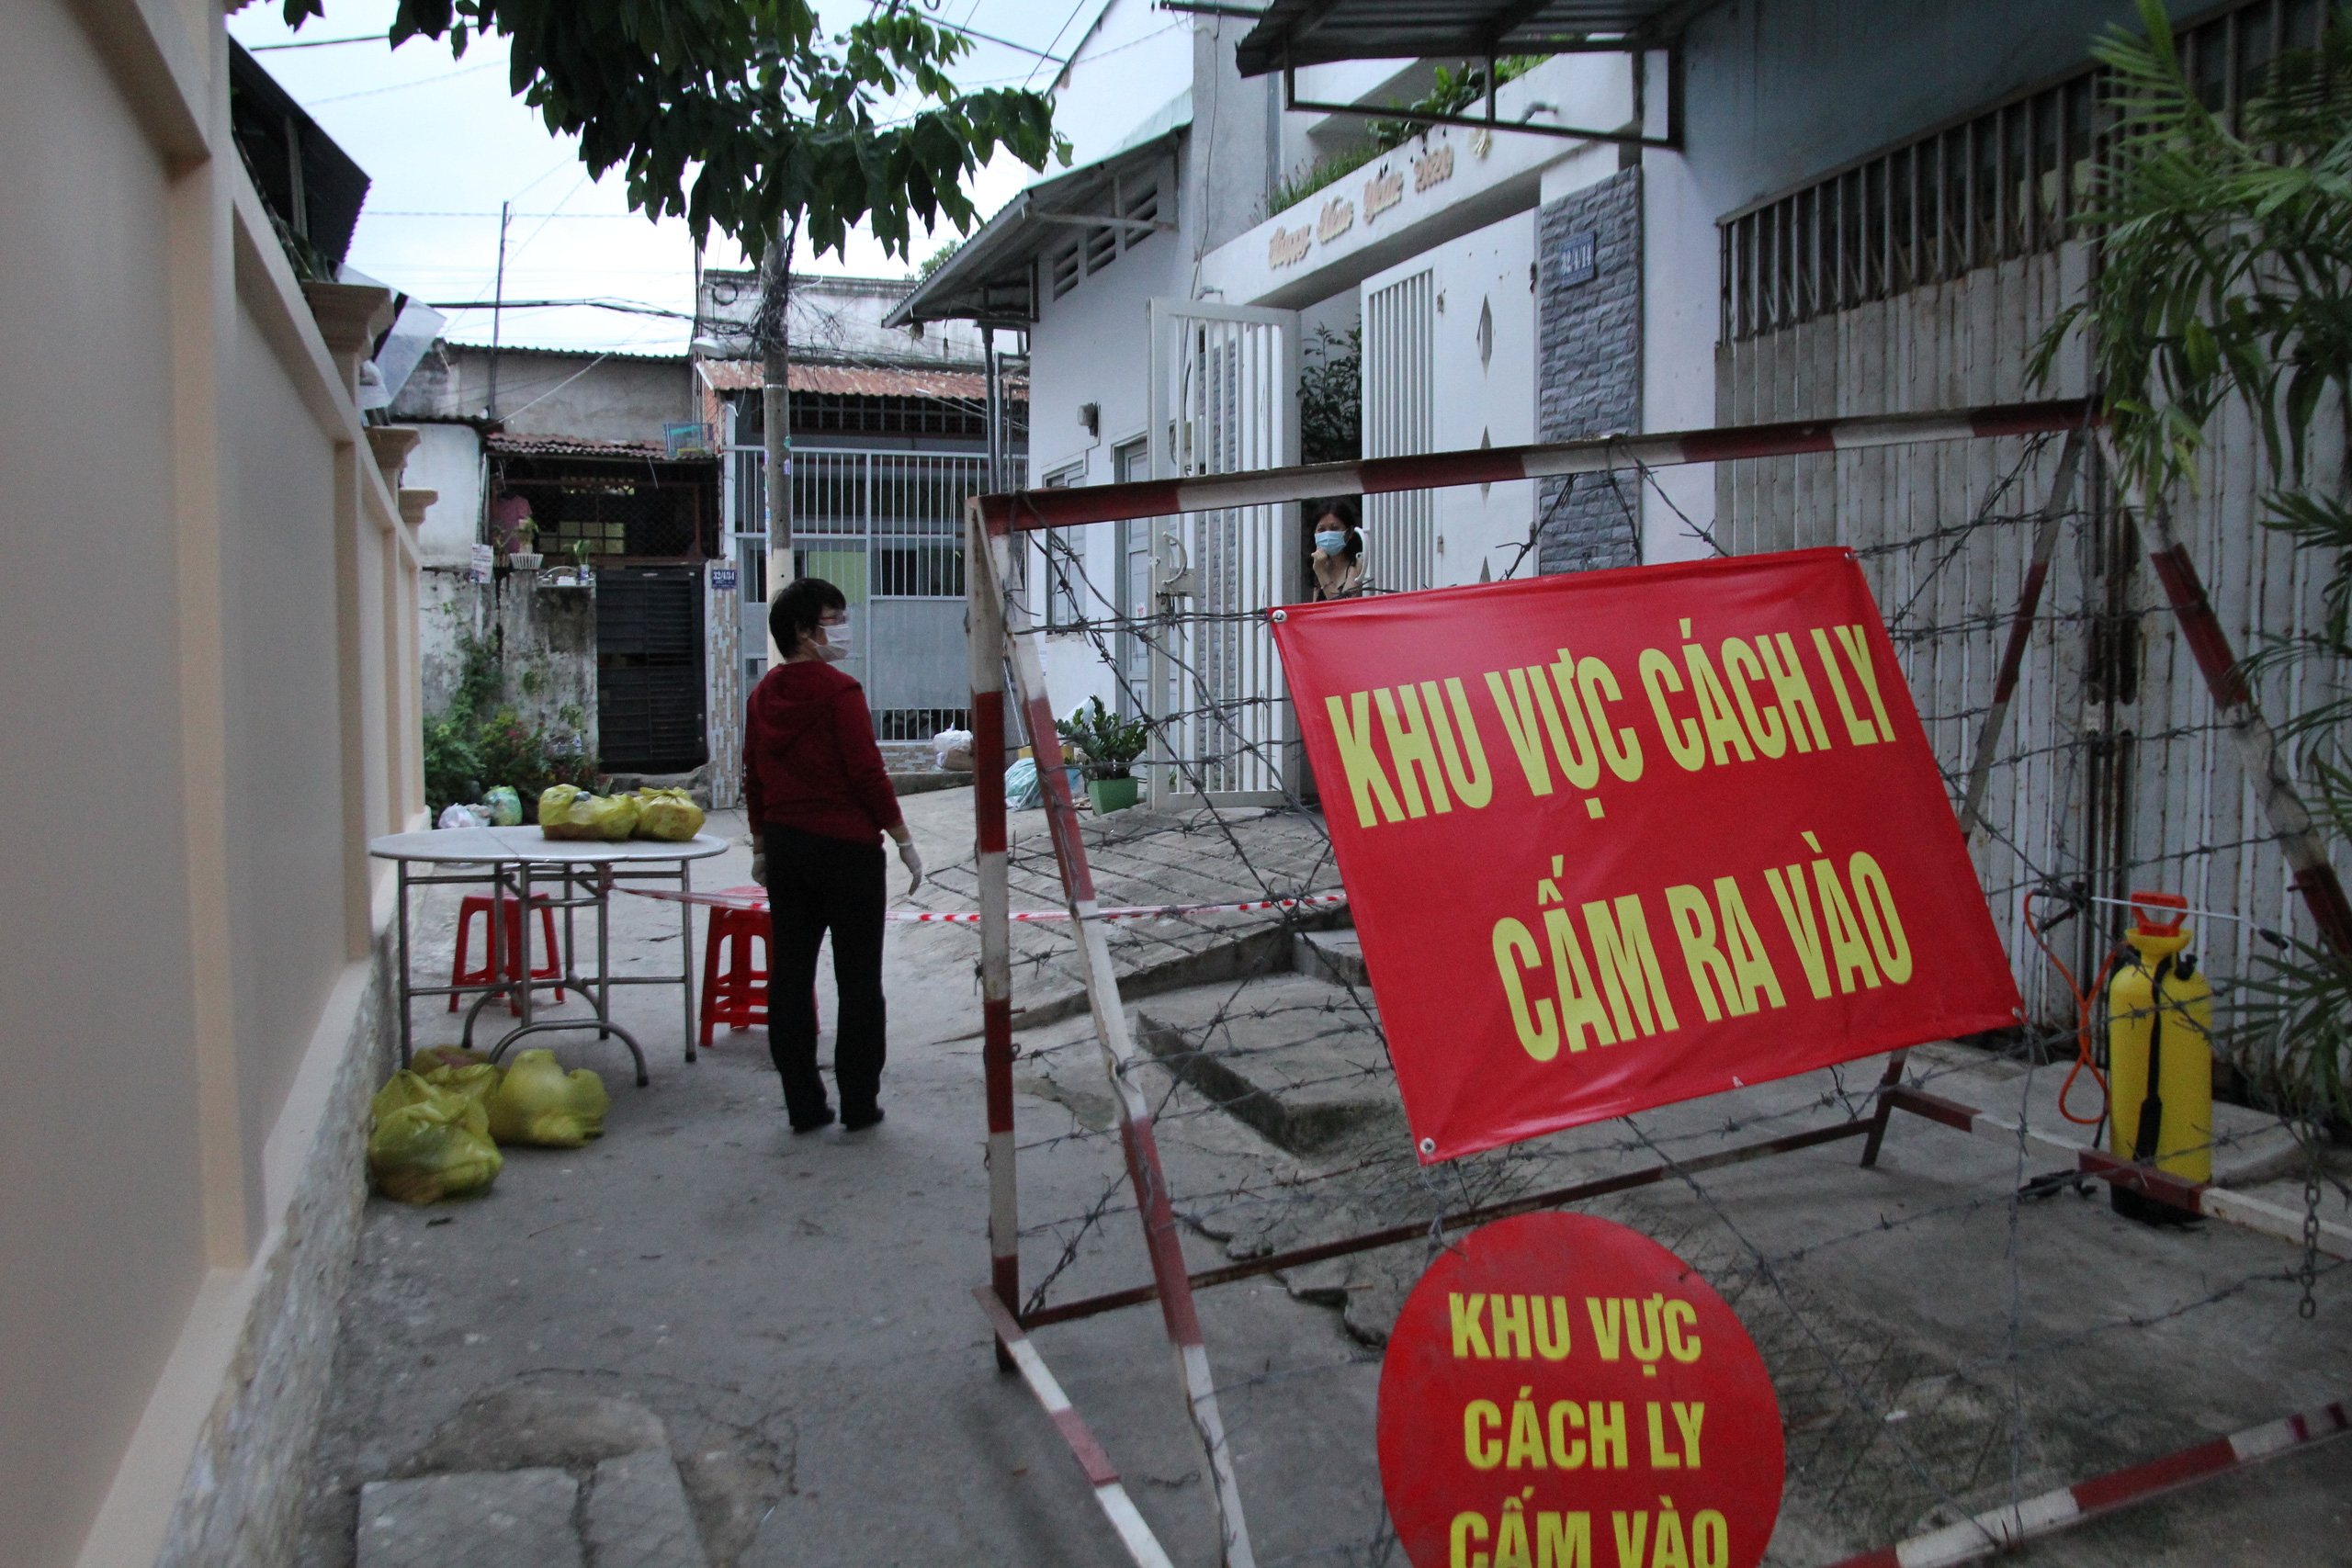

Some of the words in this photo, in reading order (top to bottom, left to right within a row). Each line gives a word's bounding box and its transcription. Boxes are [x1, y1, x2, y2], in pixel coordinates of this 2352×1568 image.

[1326, 679, 1492, 828] KHU
[1485, 649, 1644, 818] VỰC
[1639, 618, 1831, 772] CÁCH
[1811, 625, 1895, 745] LY
[1493, 855, 1679, 1061] CẤM
[1665, 876, 1786, 1021] RA
[1764, 831, 1912, 998] VÀO
[1449, 1292, 1570, 1360] KHU
[1586, 1293, 1701, 1376] VỰC
[1464, 1386, 1628, 1469] CÁCH
[1646, 1402, 1704, 1468] LY
[1451, 1486, 1590, 1568] CẤM
[1612, 1496, 1728, 1568] VÀO
